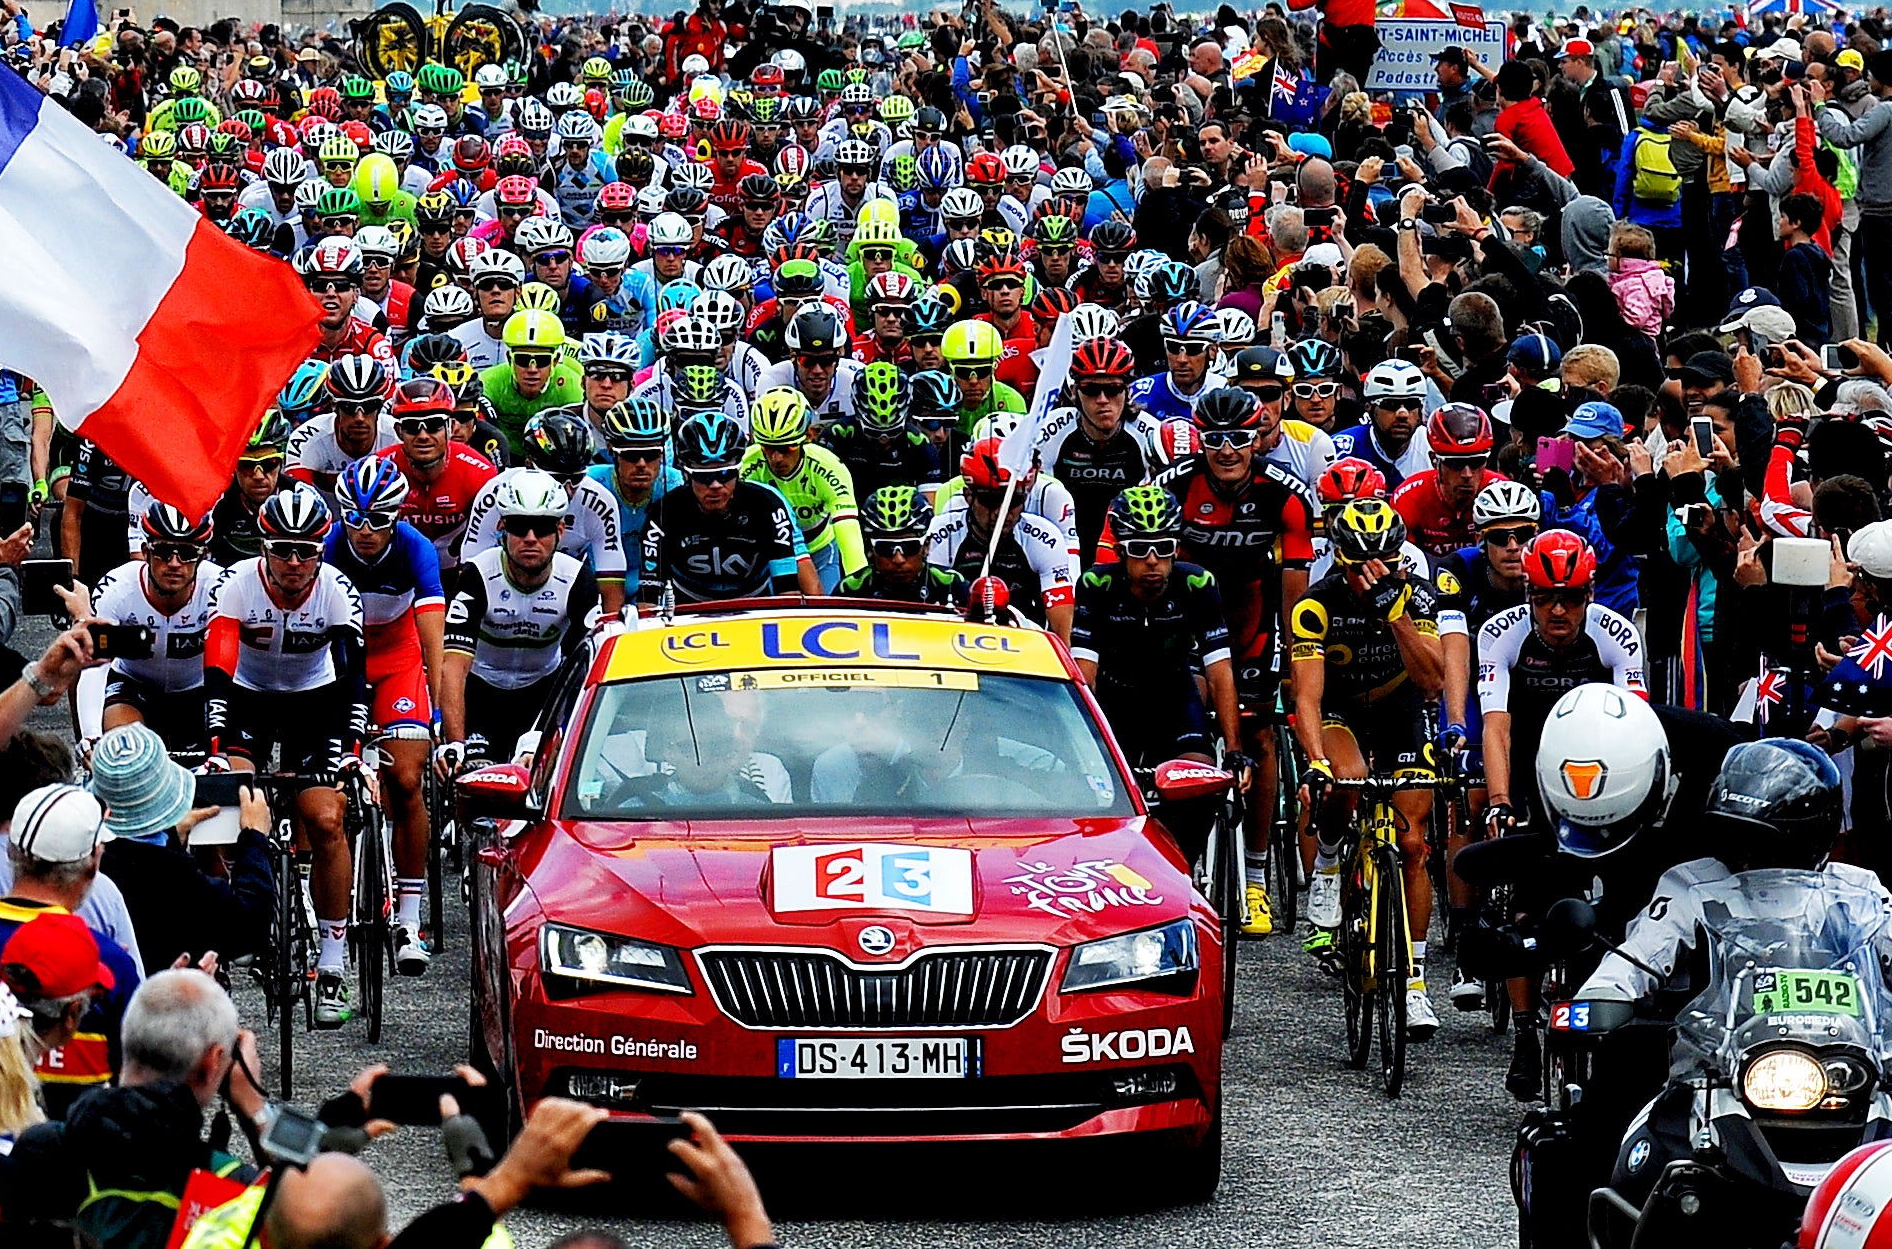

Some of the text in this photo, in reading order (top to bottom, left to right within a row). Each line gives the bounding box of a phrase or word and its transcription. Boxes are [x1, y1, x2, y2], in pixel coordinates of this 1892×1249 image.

[1375, 27, 1500, 44] T-SAINT-MICHEL
[1376, 48, 1423, 64] Accès
[1375, 70, 1438, 84] Pedestr
[727, 384, 746, 420] nweb
[287, 424, 320, 459] IAM
[1040, 412, 1075, 443] BORA
[79, 438, 96, 463] sk
[806, 455, 851, 498] Tinkoff
[1069, 467, 1126, 480] BORA
[1151, 458, 1196, 487] MC
[402, 512, 466, 525] ATUSHA
[464, 482, 502, 546] Tinko
[579, 486, 619, 552] Tinkoff
[771, 507, 791, 547] sky
[642, 519, 666, 558] sky
[931, 520, 965, 545] BORA
[1022, 522, 1057, 550] BORA
[1181, 526, 1274, 547] BMC
[688, 545, 760, 579] sky
[90, 574, 117, 618] AM
[335, 573, 364, 617] IAM
[483, 619, 541, 631] dimension
[512, 627, 541, 638] data
[1484, 605, 1529, 639] BORA
[1598, 612, 1640, 657] BORA
[666, 621, 1021, 662] LCL LCL LCL
[1357, 643, 1399, 656] direc
[781, 672, 944, 685] OFFICIEL 1
[1526, 676, 1592, 688] BORA
[209, 698, 228, 729] IAM
[349, 702, 369, 734] IAM
[1726, 792, 1772, 808] SCOTT
[826, 857, 932, 896] 2 3
[1794, 977, 1852, 1008] 542
[1555, 1006, 1590, 1027] 2 3
[1767, 1015, 1845, 1027] EUROMEDIA
[533, 1028, 698, 1060] Direction Générale
[797, 1042, 963, 1074] DS-413-MH
[1061, 1026, 1195, 1063] ŠKODA
